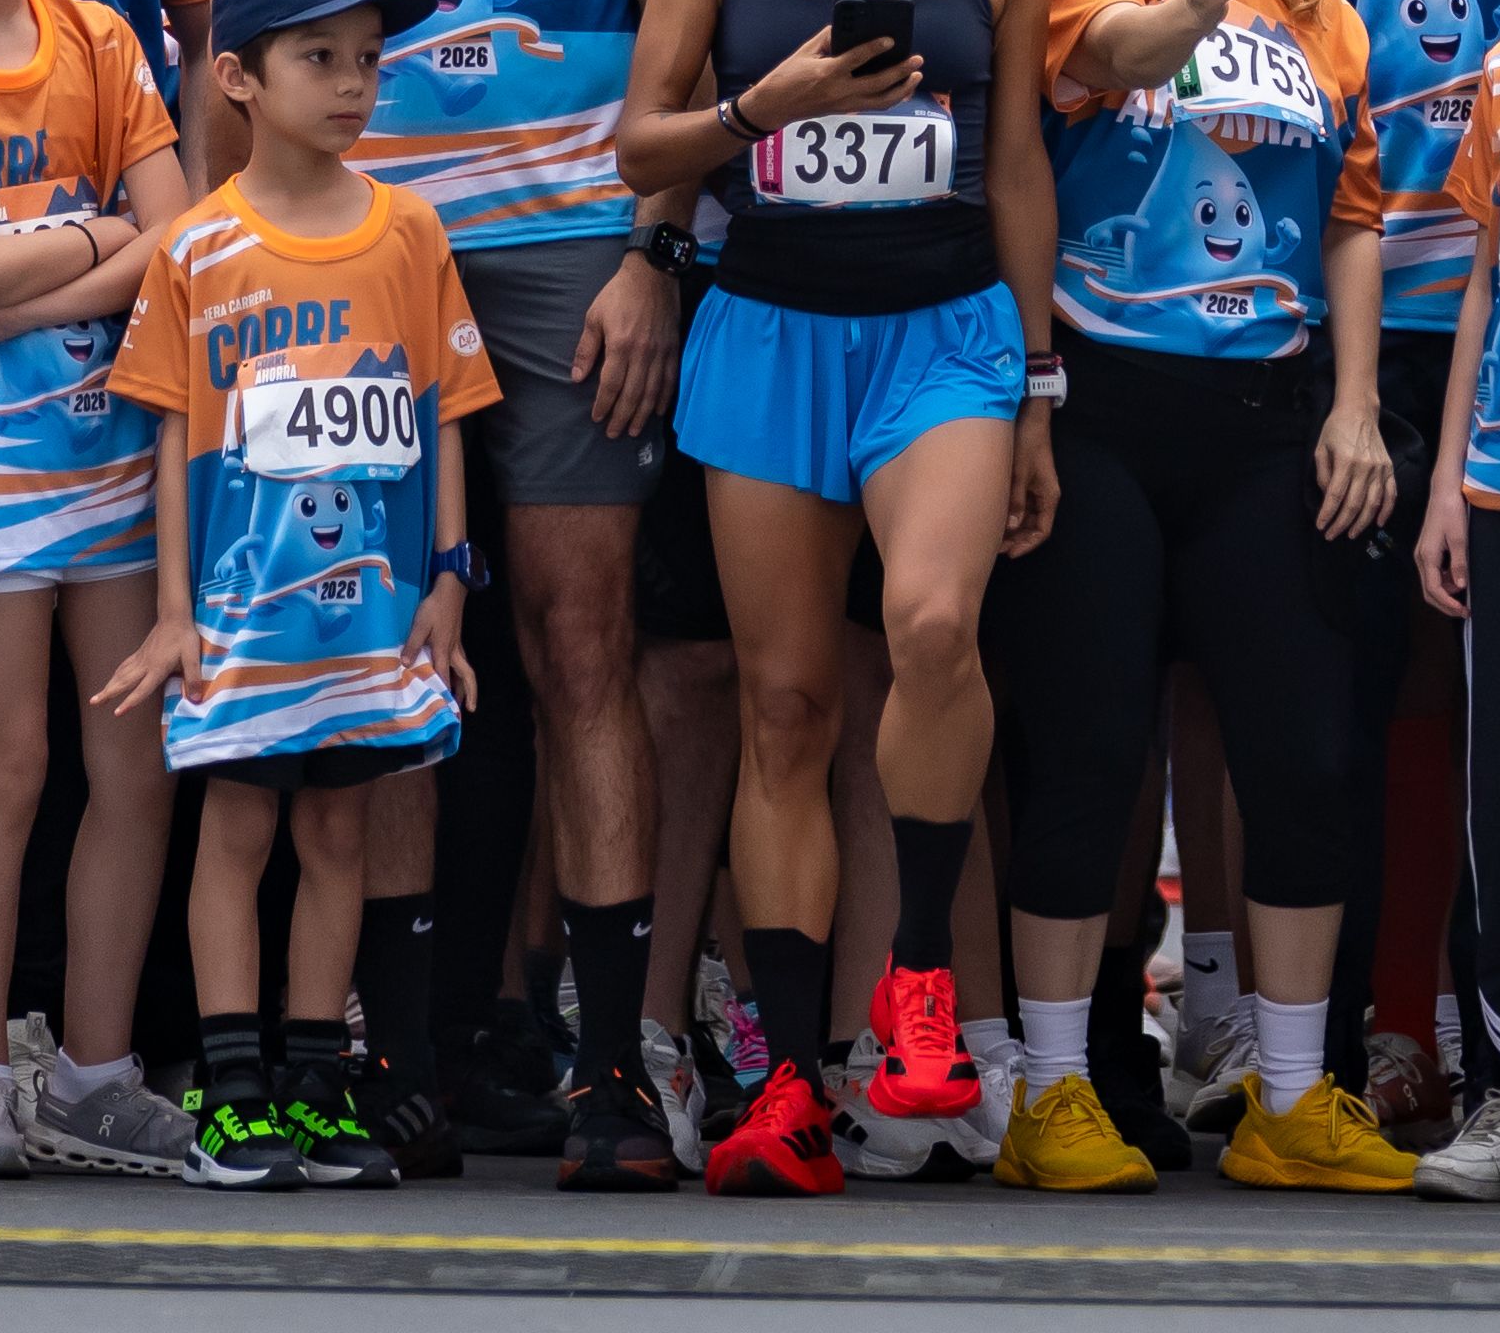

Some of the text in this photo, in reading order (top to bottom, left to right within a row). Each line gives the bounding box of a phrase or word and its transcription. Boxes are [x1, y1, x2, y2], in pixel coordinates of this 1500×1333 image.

[439, 46, 489, 69] 2026
[1210, 32, 1315, 108] 3753
[1177, 82, 1201, 99] 3K
[1430, 99, 1472, 124] 2026
[795, 121, 938, 186] 3371
[202, 288, 274, 323] 1ERA CARRERA
[1205, 293, 1249, 316] 2026
[207, 299, 352, 392] CORRE
[254, 365, 298, 386] AHORRA
[74, 391, 108, 414] 2026
[285, 384, 415, 450] 4900
[320, 579, 357, 601] 2026
